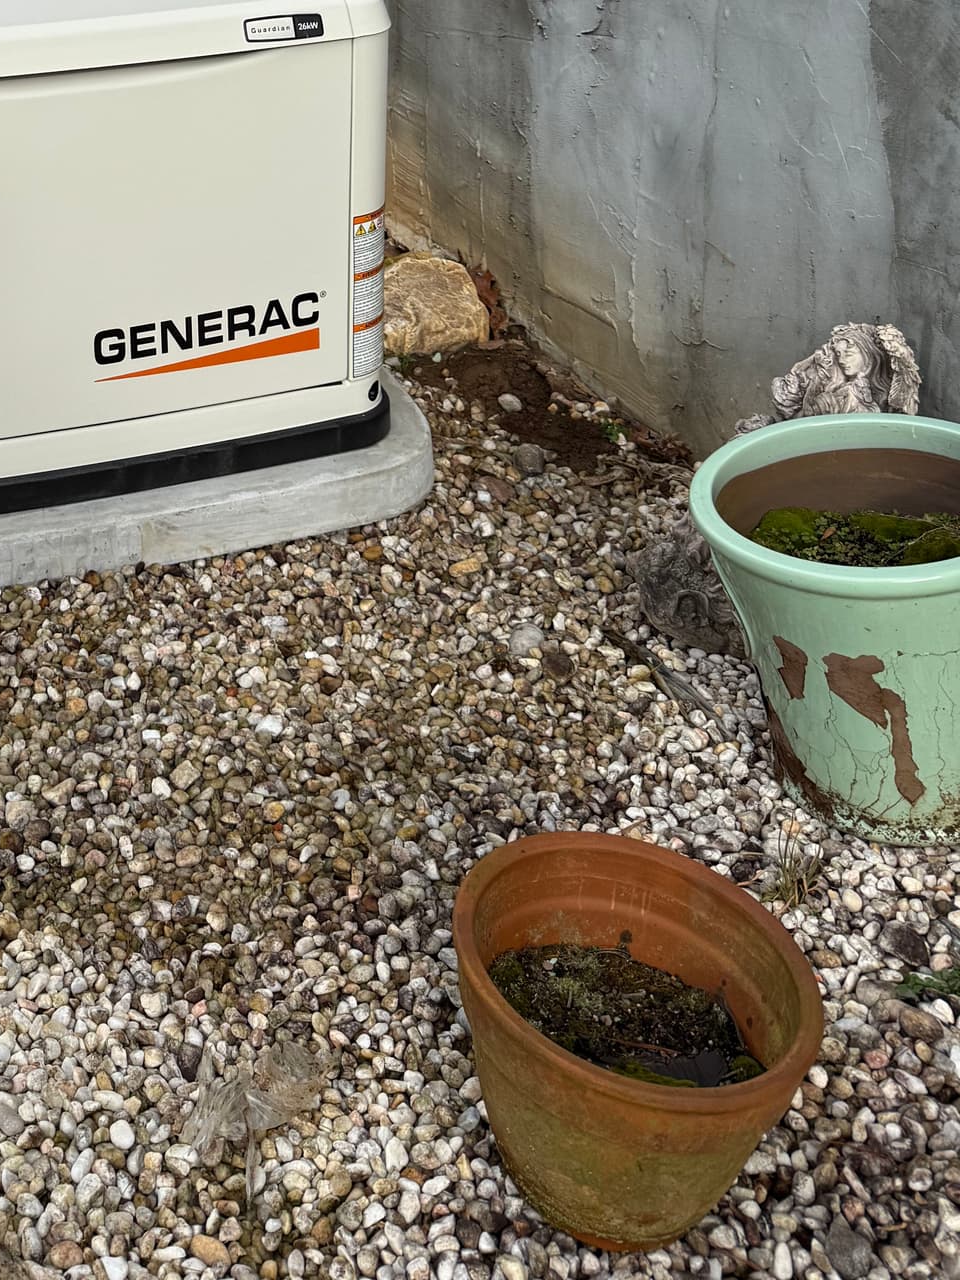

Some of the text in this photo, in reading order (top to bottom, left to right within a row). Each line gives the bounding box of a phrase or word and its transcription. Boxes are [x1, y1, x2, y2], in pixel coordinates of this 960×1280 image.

[250, 21, 319, 34] Guardian 26kW
[93, 291, 320, 365] GENERAC
